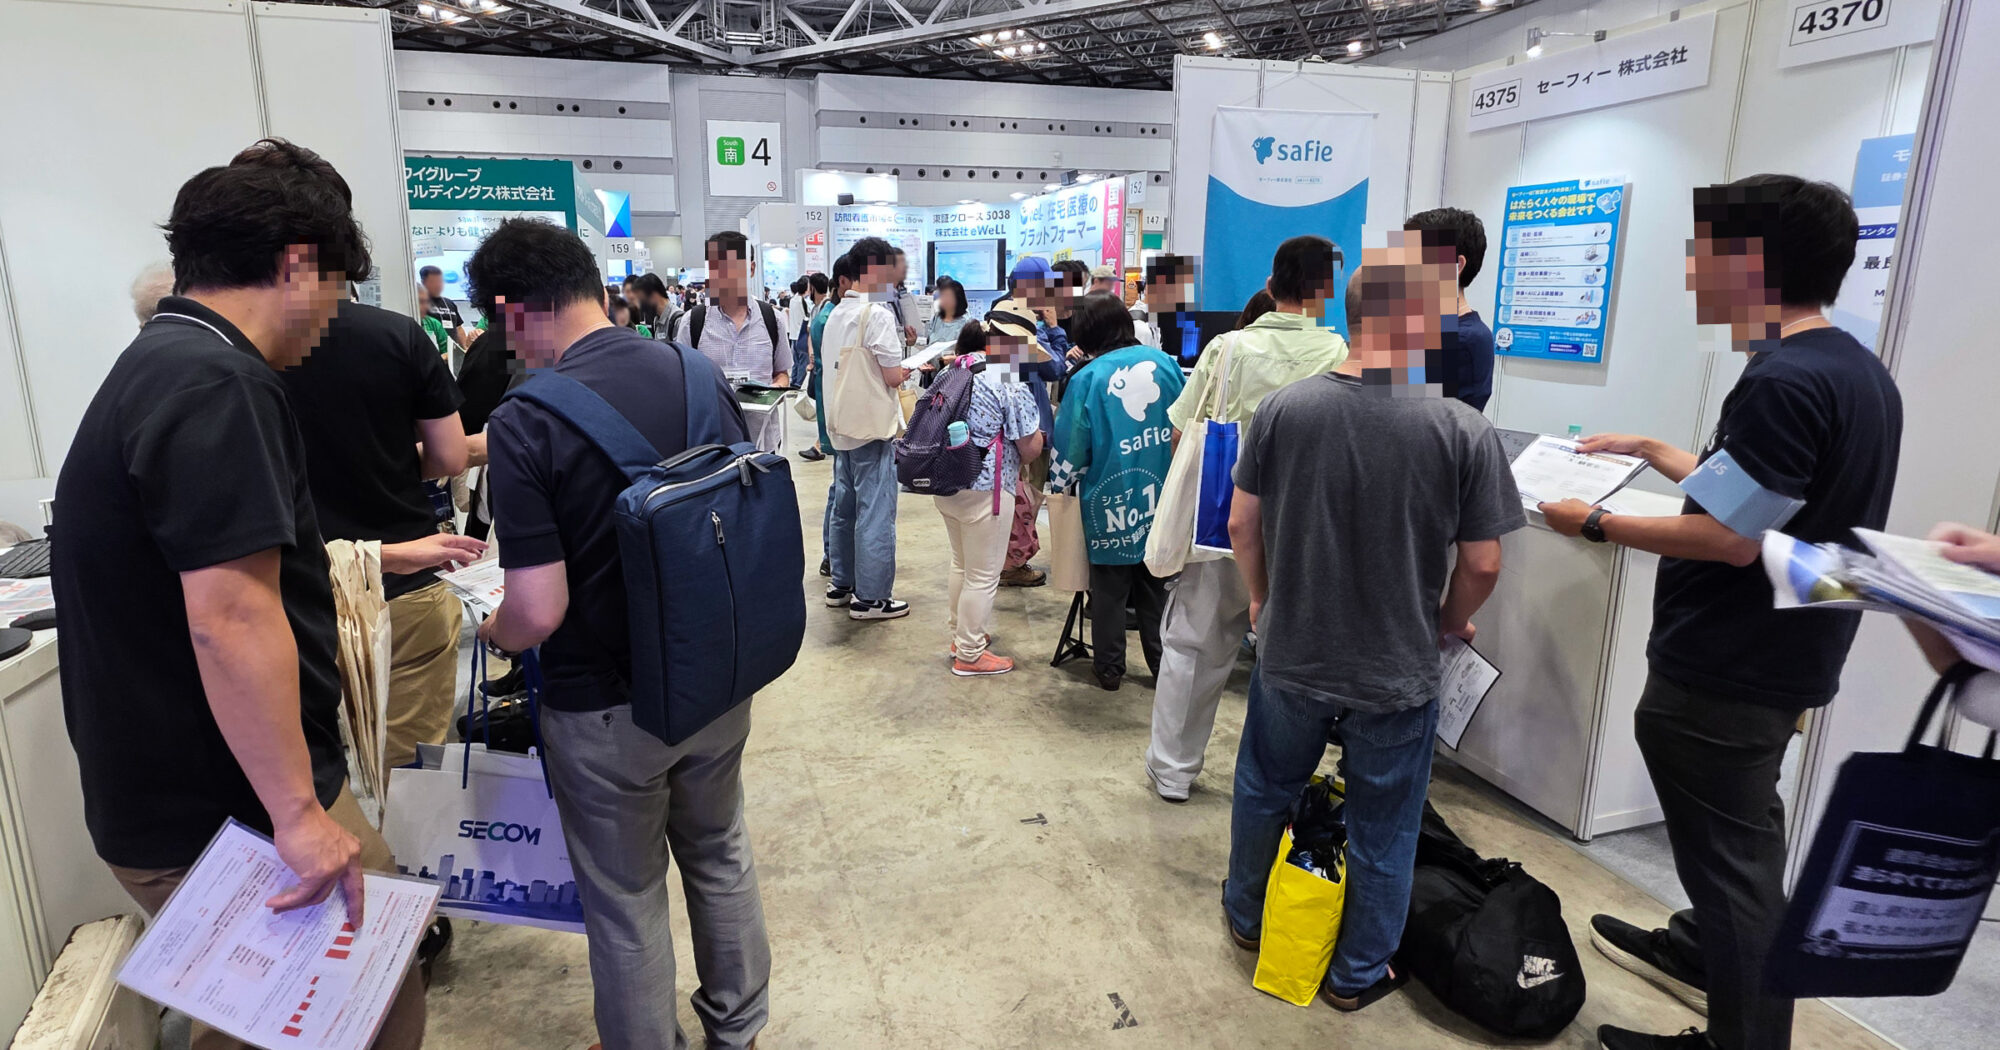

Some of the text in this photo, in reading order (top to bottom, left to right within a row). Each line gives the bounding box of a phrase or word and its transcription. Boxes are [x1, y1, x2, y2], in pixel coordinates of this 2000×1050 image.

[1798, 0, 1884, 35] 4370
[1475, 45, 1688, 110] 4375 セーフィー 株式会社
[724, 138, 771, 166] 南 4
[1277, 140, 1333, 162] safie
[1130, 182, 1142, 195] 152
[806, 211, 822, 221] 152
[933, 210, 1011, 224] 東証グロース 5038
[1146, 216, 1160, 225] 147
[1508, 205, 1596, 221] 未来をつくる会社です
[935, 224, 1006, 237] 株式会社 eWeLL
[1020, 221, 1097, 247] プラットフォーマー
[611, 244, 630, 253] 159
[1119, 426, 1171, 455] safie
[1101, 488, 1134, 506] シェア
[1104, 483, 1156, 533] No.1
[458, 820, 541, 845] SECOM
